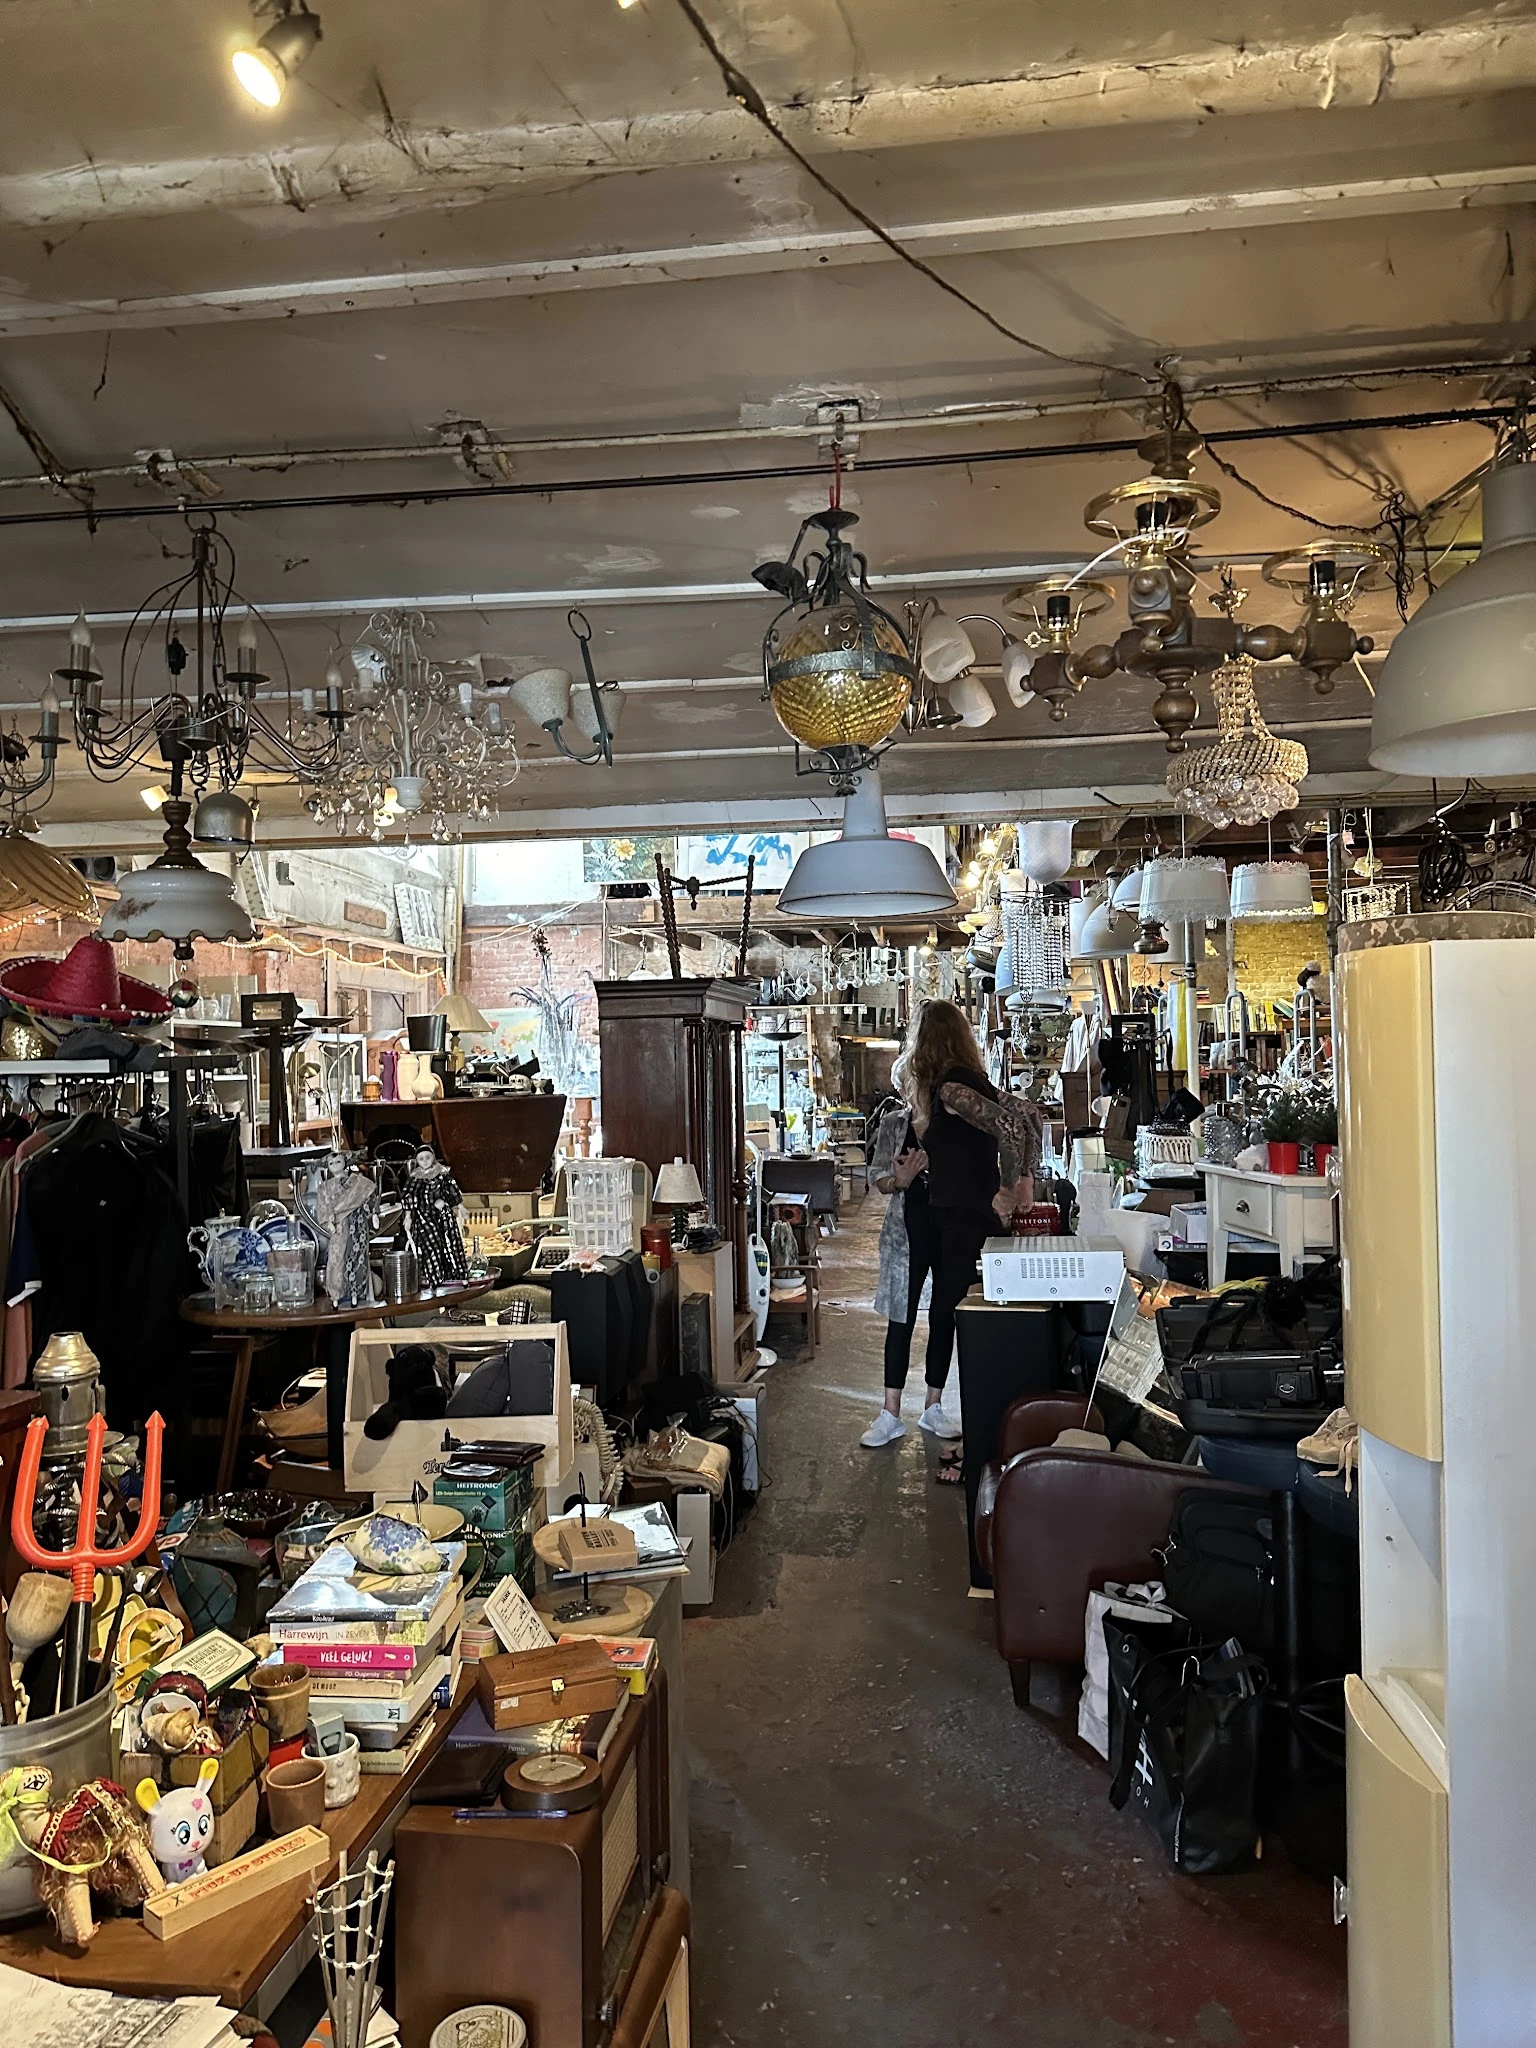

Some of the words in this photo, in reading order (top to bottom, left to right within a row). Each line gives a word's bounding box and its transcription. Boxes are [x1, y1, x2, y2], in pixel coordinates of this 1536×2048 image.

[280, 1630, 328, 1640] Harrewijn
[346, 1630, 369, 1639] ZEVEN
[320, 1651, 339, 1663] VEEL
[341, 1650, 372, 1664] GELUK!
